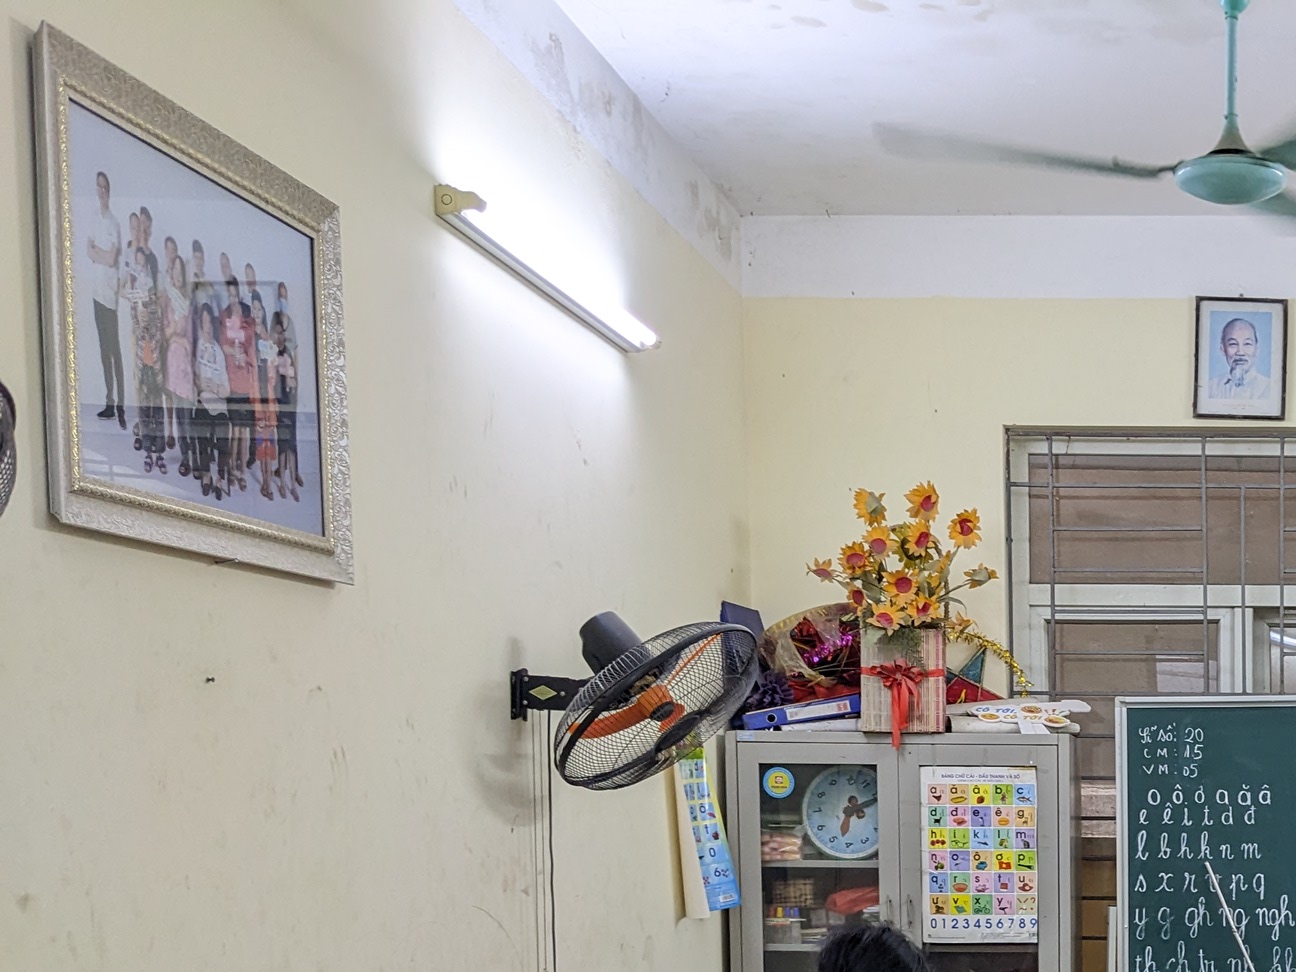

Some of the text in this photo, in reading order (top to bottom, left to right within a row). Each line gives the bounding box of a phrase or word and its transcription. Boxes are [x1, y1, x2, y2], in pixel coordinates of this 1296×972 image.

[1184, 728, 1203, 743] 20
[1184, 744, 1203, 759] 15
[1183, 764, 1198, 778] 05
[1148, 789, 1160, 805] o
[1172, 784, 1183, 804] ô
[1216, 789, 1231, 807] a
[1238, 784, 1251, 805] ă
[1259, 785, 1271, 804] â
[1139, 809, 1149, 824] e
[1162, 802, 1176, 824] ê
[1221, 807, 1233, 825] d
[1135, 830, 1261, 860] l b h k n m
[1135, 874, 1146, 892] s
[1155, 873, 1173, 892] x
[1183, 872, 1198, 892] r
[1133, 908, 1149, 940] y
[1185, 896, 1214, 939] gh
[1256, 894, 1295, 941] ngh
